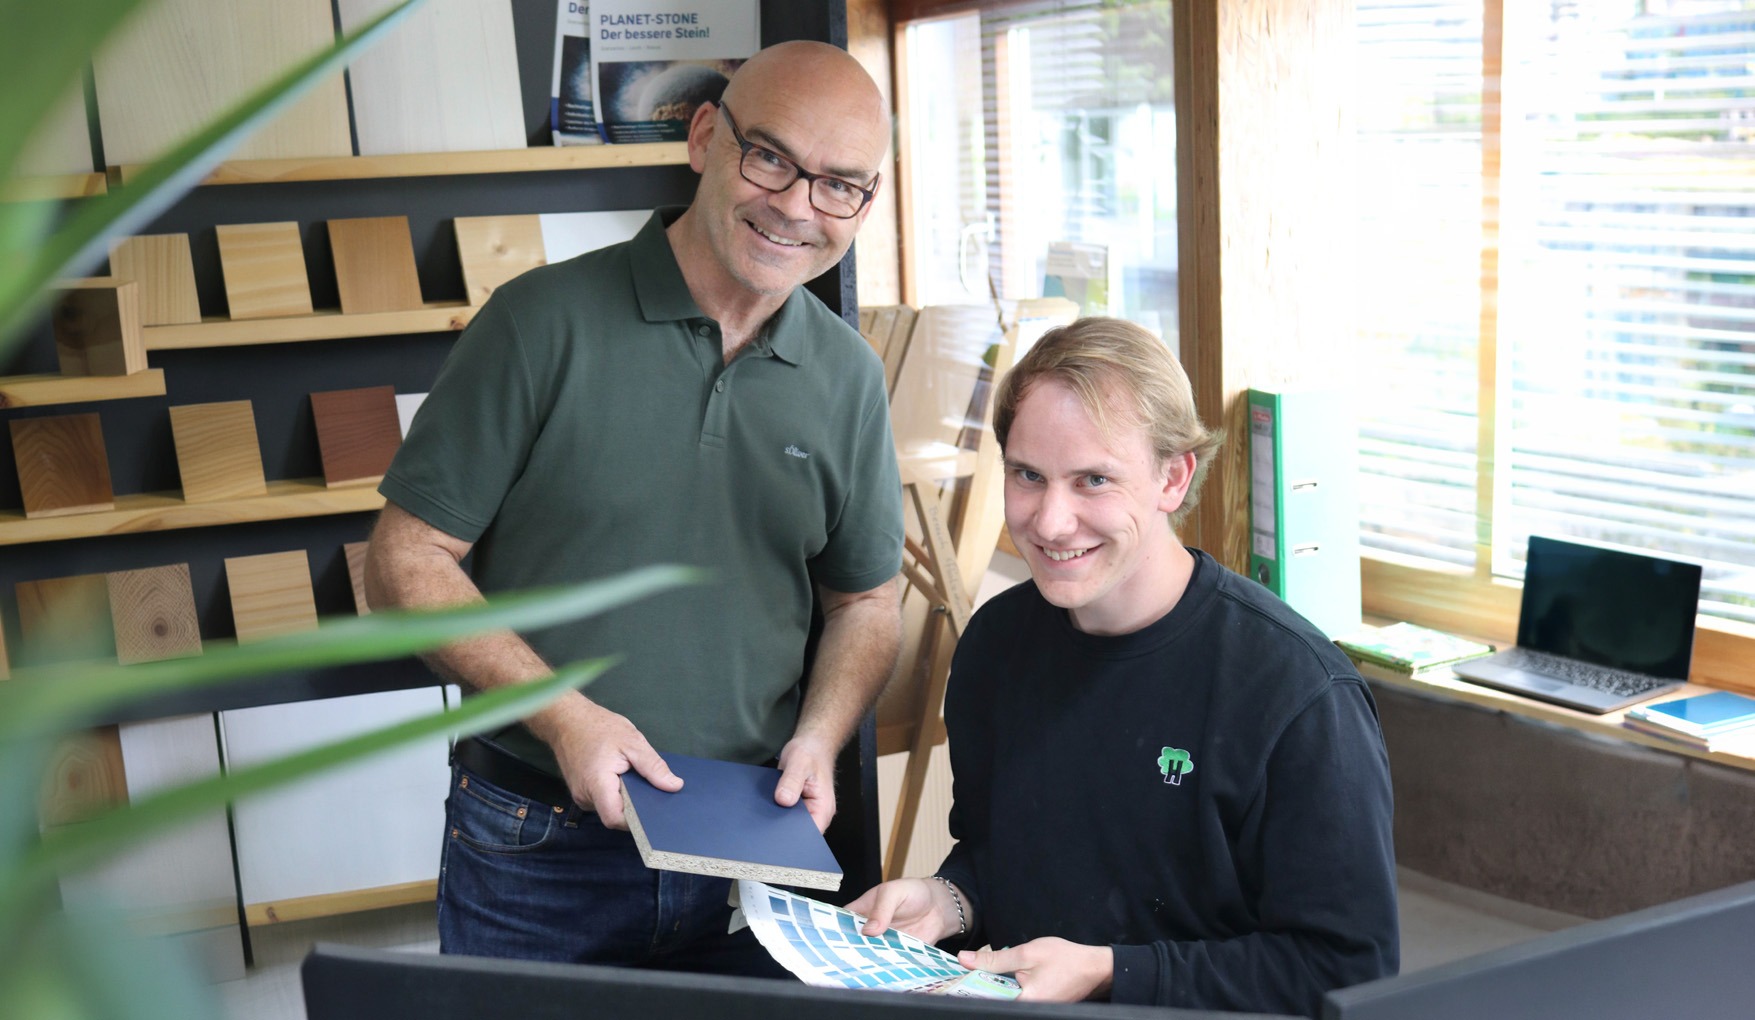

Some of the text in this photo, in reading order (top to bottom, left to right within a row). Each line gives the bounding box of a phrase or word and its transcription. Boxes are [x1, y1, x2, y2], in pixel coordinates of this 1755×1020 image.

[569, 2, 589, 14] Der
[600, 13, 698, 25] PLANET-STONE
[601, 27, 710, 40] Der bessere Stein!
[1164, 759, 1183, 784] H
